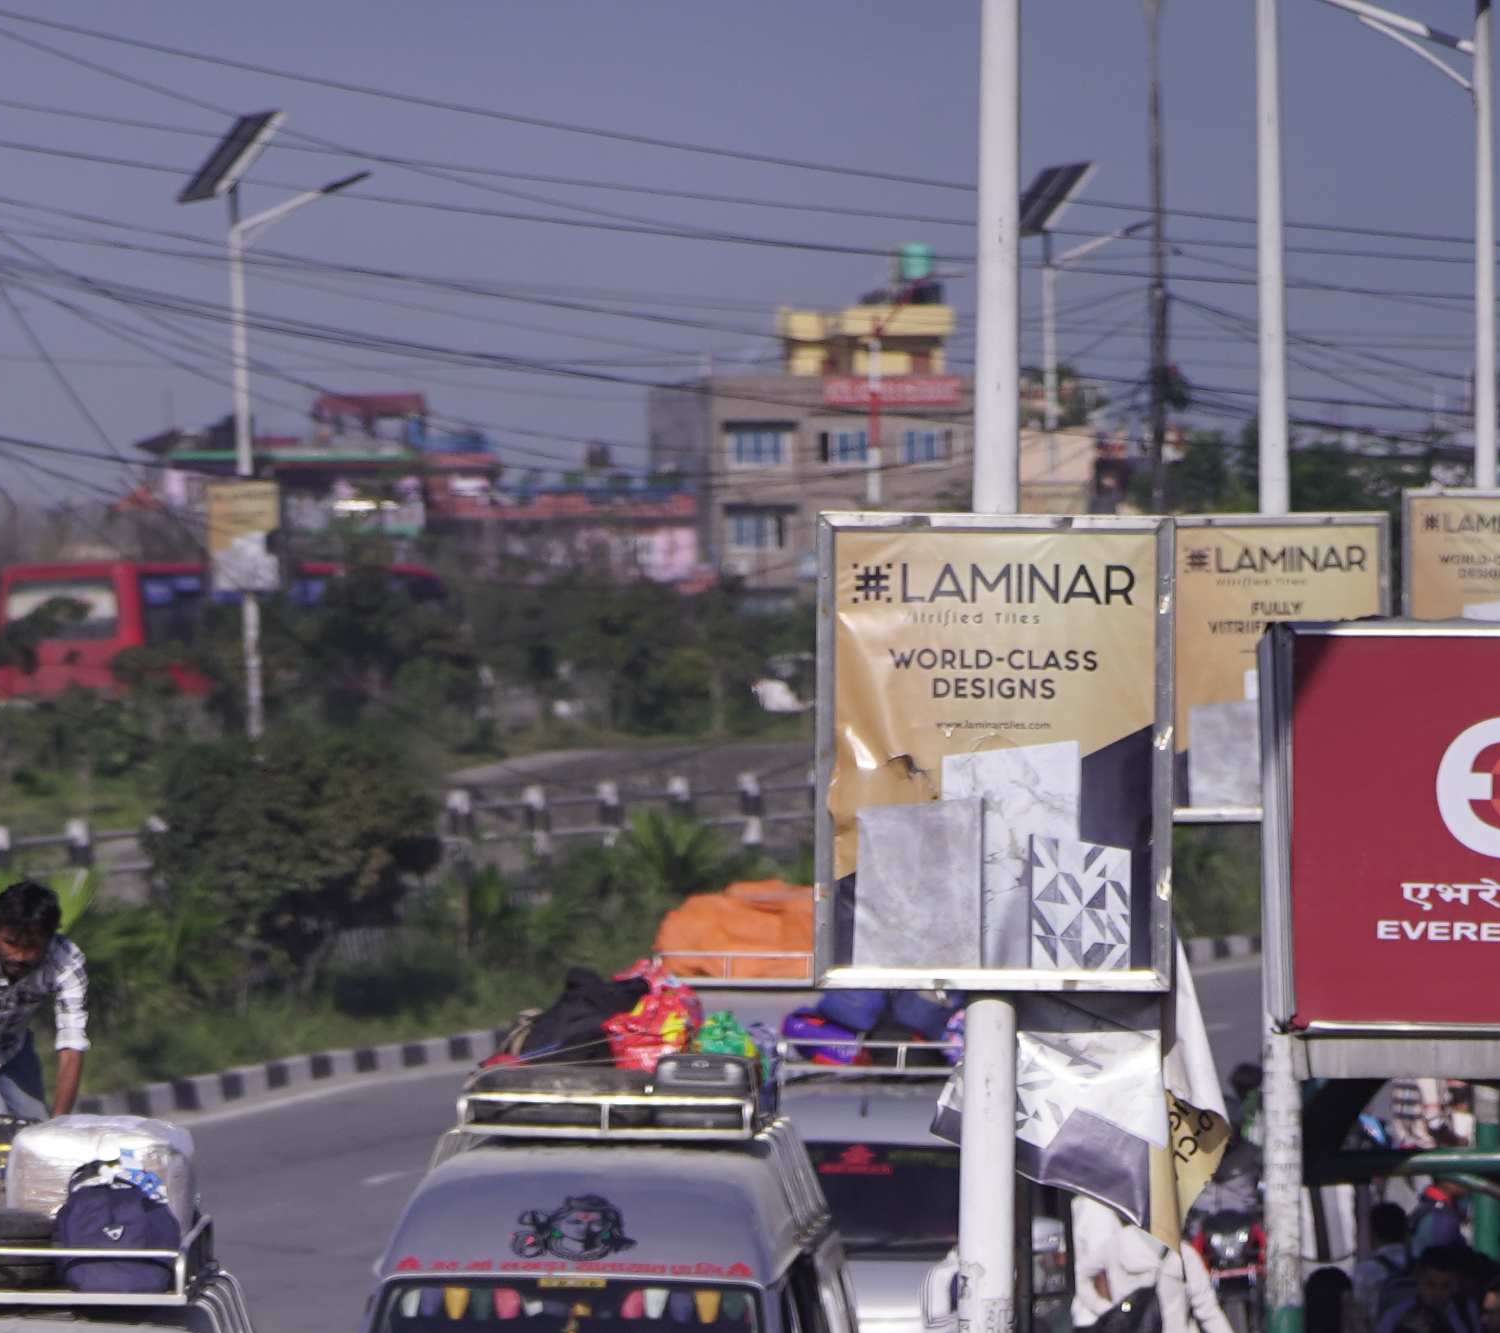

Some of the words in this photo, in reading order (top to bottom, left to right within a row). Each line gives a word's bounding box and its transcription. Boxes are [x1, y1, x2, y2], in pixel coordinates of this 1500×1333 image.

[1250, 600, 1303, 616] FULLY
[994, 612, 1042, 625] Tiles
[1208, 621, 1272, 635] VITRIF
[889, 648, 1099, 672] WORLD-CLASS
[932, 678, 1056, 700] DESIGNS
